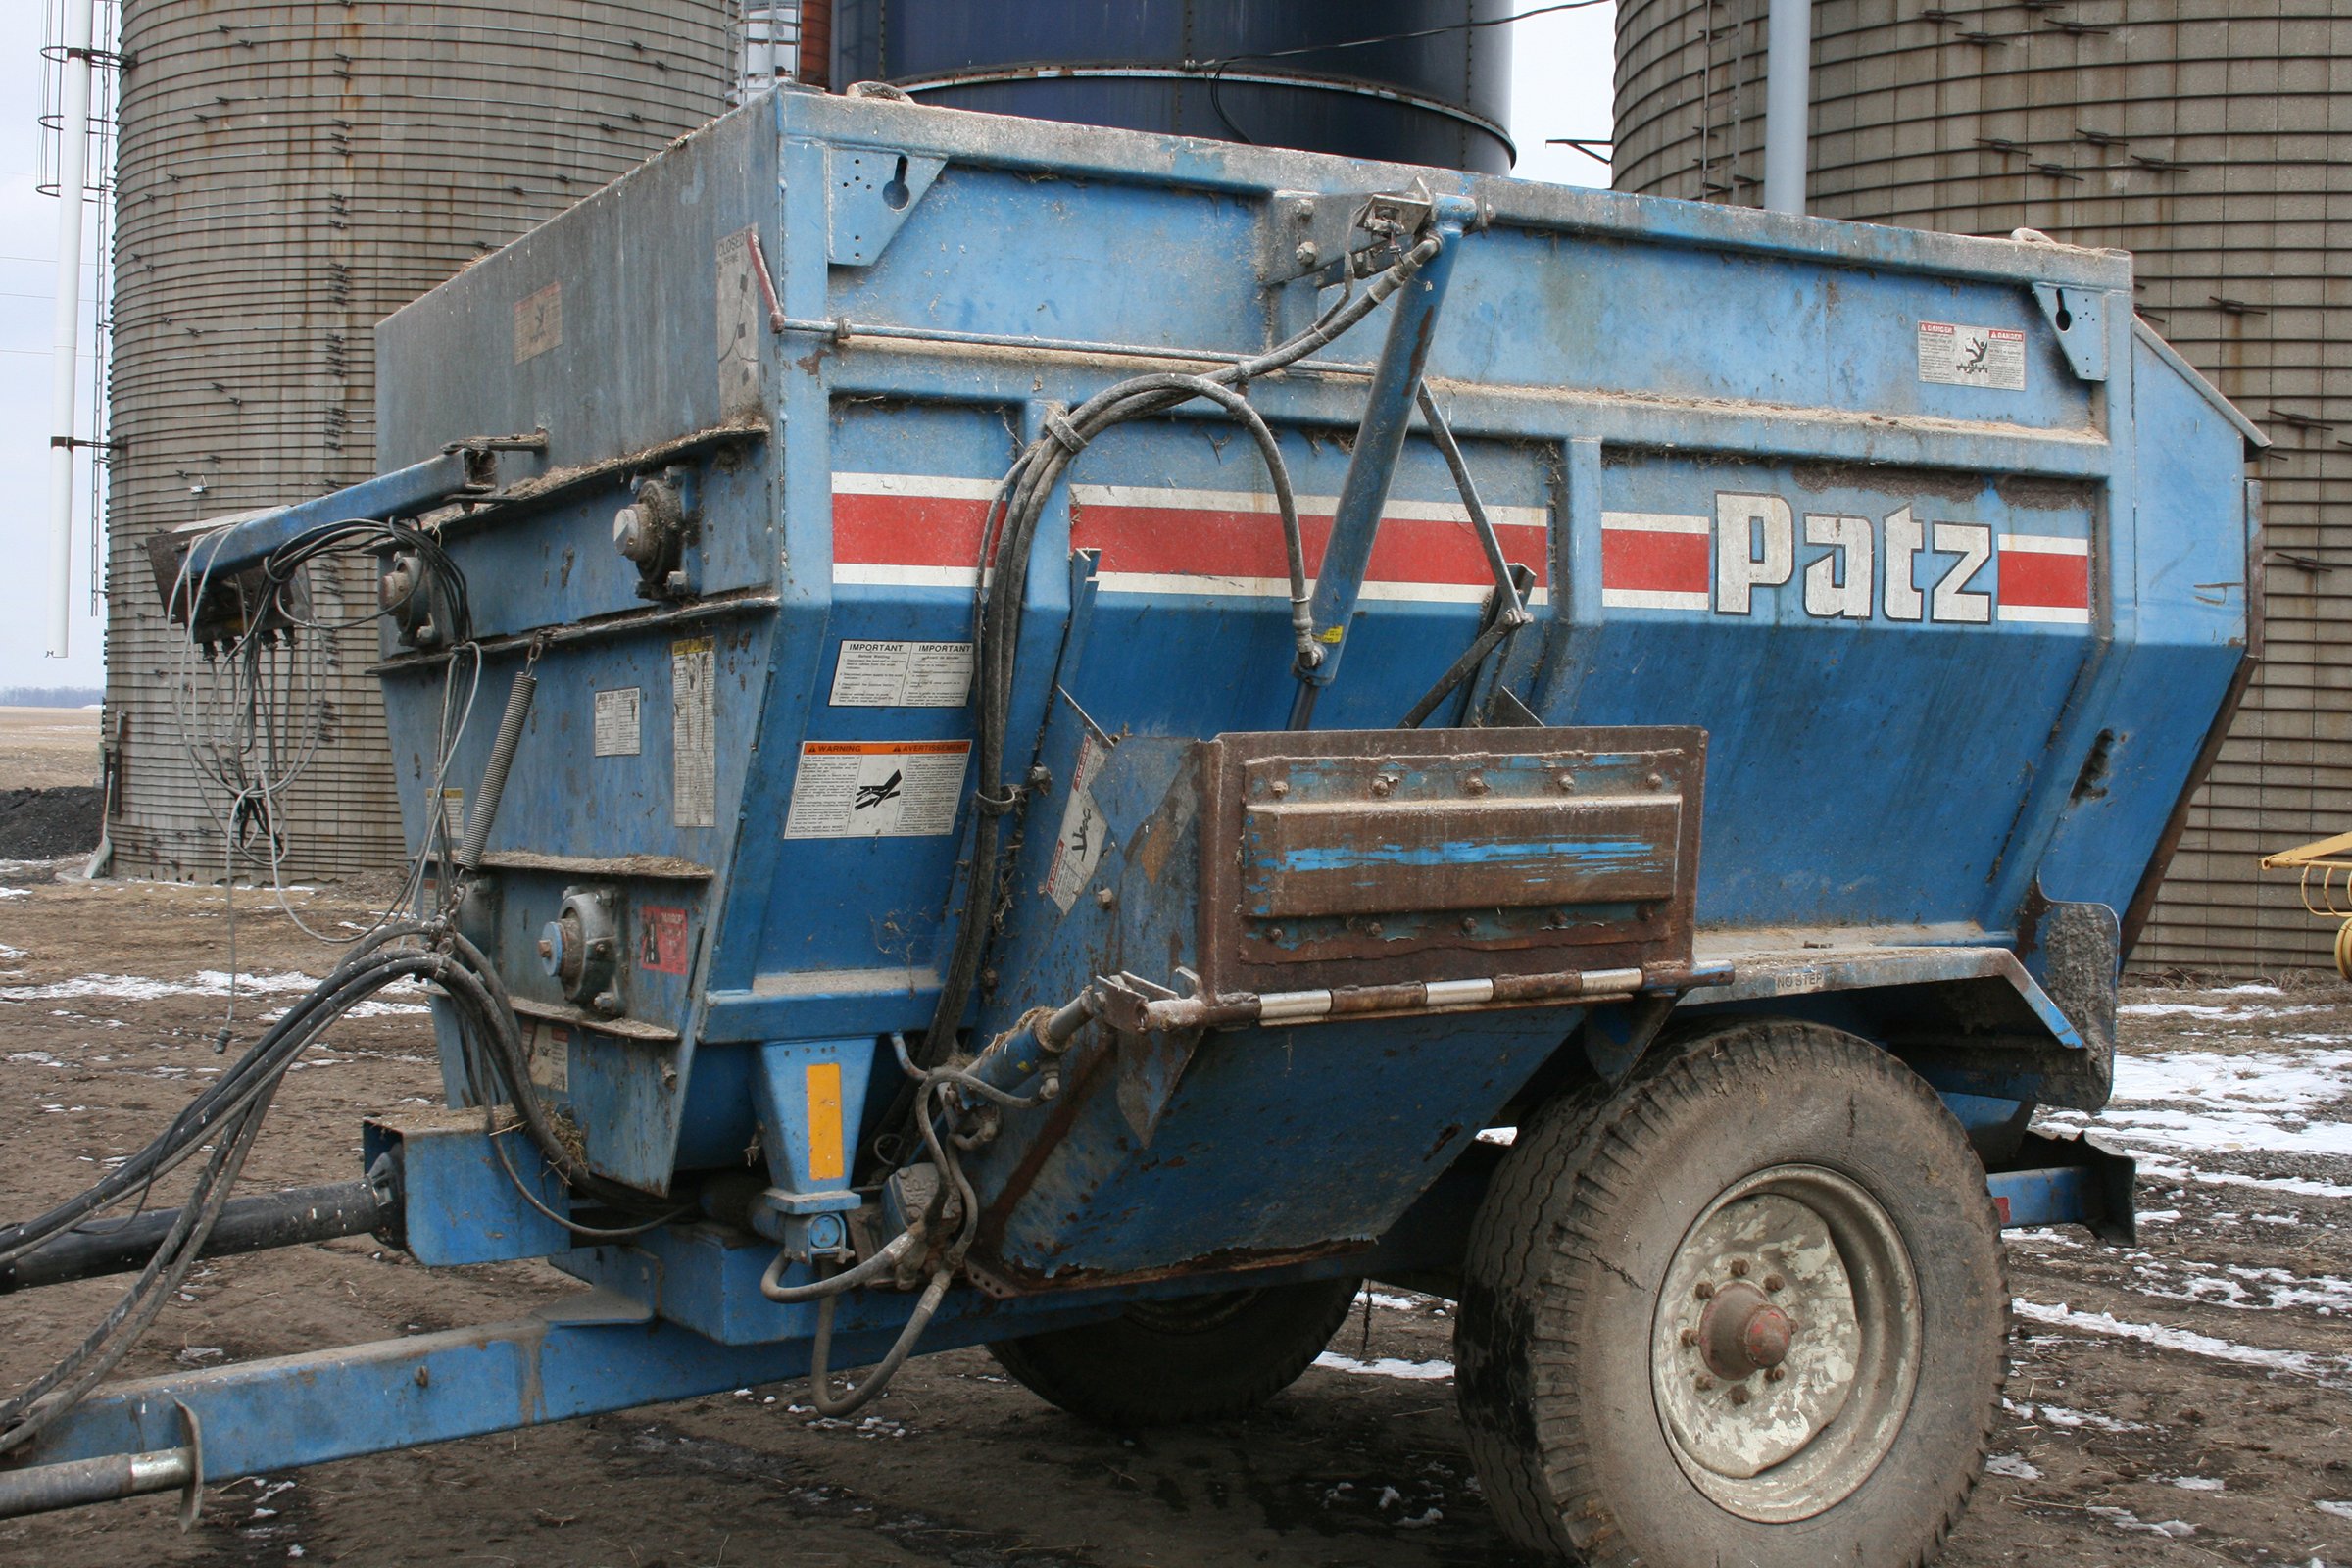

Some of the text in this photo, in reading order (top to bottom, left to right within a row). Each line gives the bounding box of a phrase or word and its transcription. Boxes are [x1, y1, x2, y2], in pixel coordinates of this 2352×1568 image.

[718, 232, 745, 256] CLOSED
[1927, 324, 1953, 333] DANGER
[1714, 490, 1992, 625] Patz
[849, 643, 904, 653] IMPORTANT
[918, 644, 972, 653] IMPORTANT
[902, 743, 967, 752] AVERTISSEMENT
[1777, 971, 1823, 989] NO STEP
